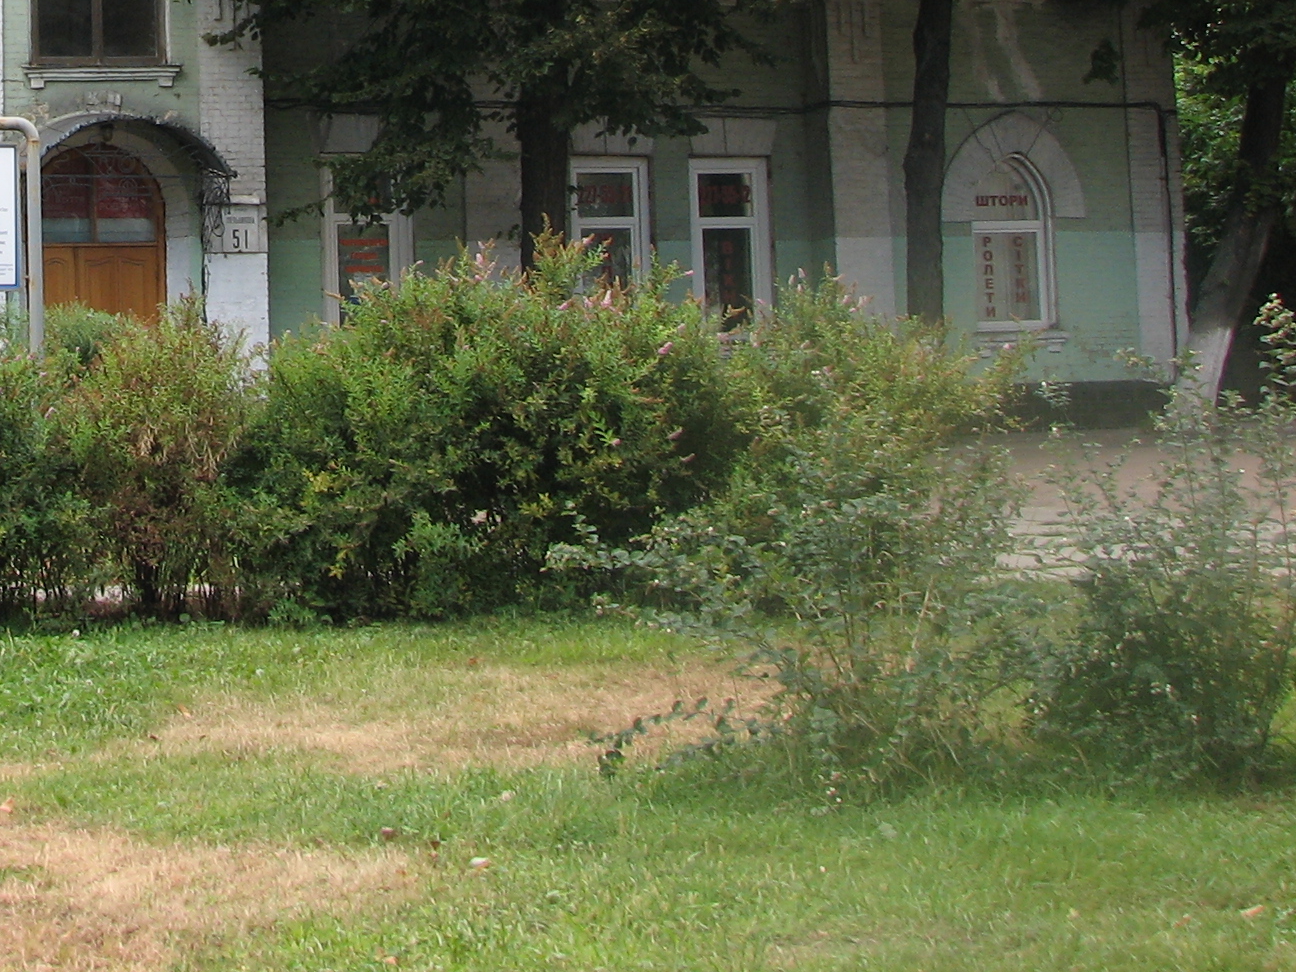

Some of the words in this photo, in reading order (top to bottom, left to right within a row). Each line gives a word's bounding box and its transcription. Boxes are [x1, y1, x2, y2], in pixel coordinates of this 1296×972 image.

[976, 195, 1028, 207] ШТОРИ
[233, 229, 248, 249] 51
[982, 236, 996, 318] РОЛЕТИ
[1013, 236, 1027, 303] СІТКИ
